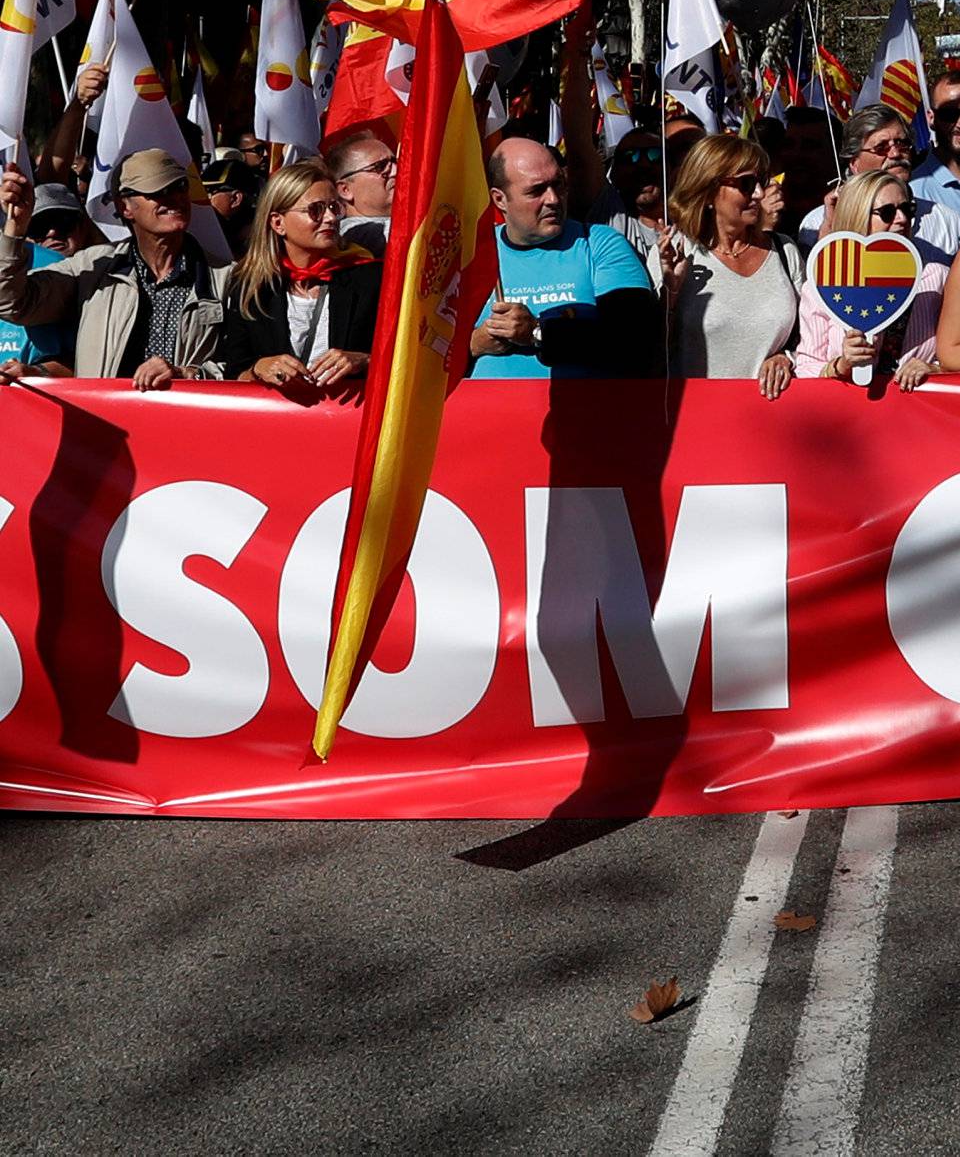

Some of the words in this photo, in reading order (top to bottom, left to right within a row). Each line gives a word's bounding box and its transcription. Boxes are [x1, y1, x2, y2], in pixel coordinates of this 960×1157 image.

[511, 284, 555, 295] CATALANS
[556, 283, 576, 291] SOM
[503, 295, 529, 306] ENT
[532, 291, 577, 305] LEGAL
[101, 480, 791, 739] SOM
